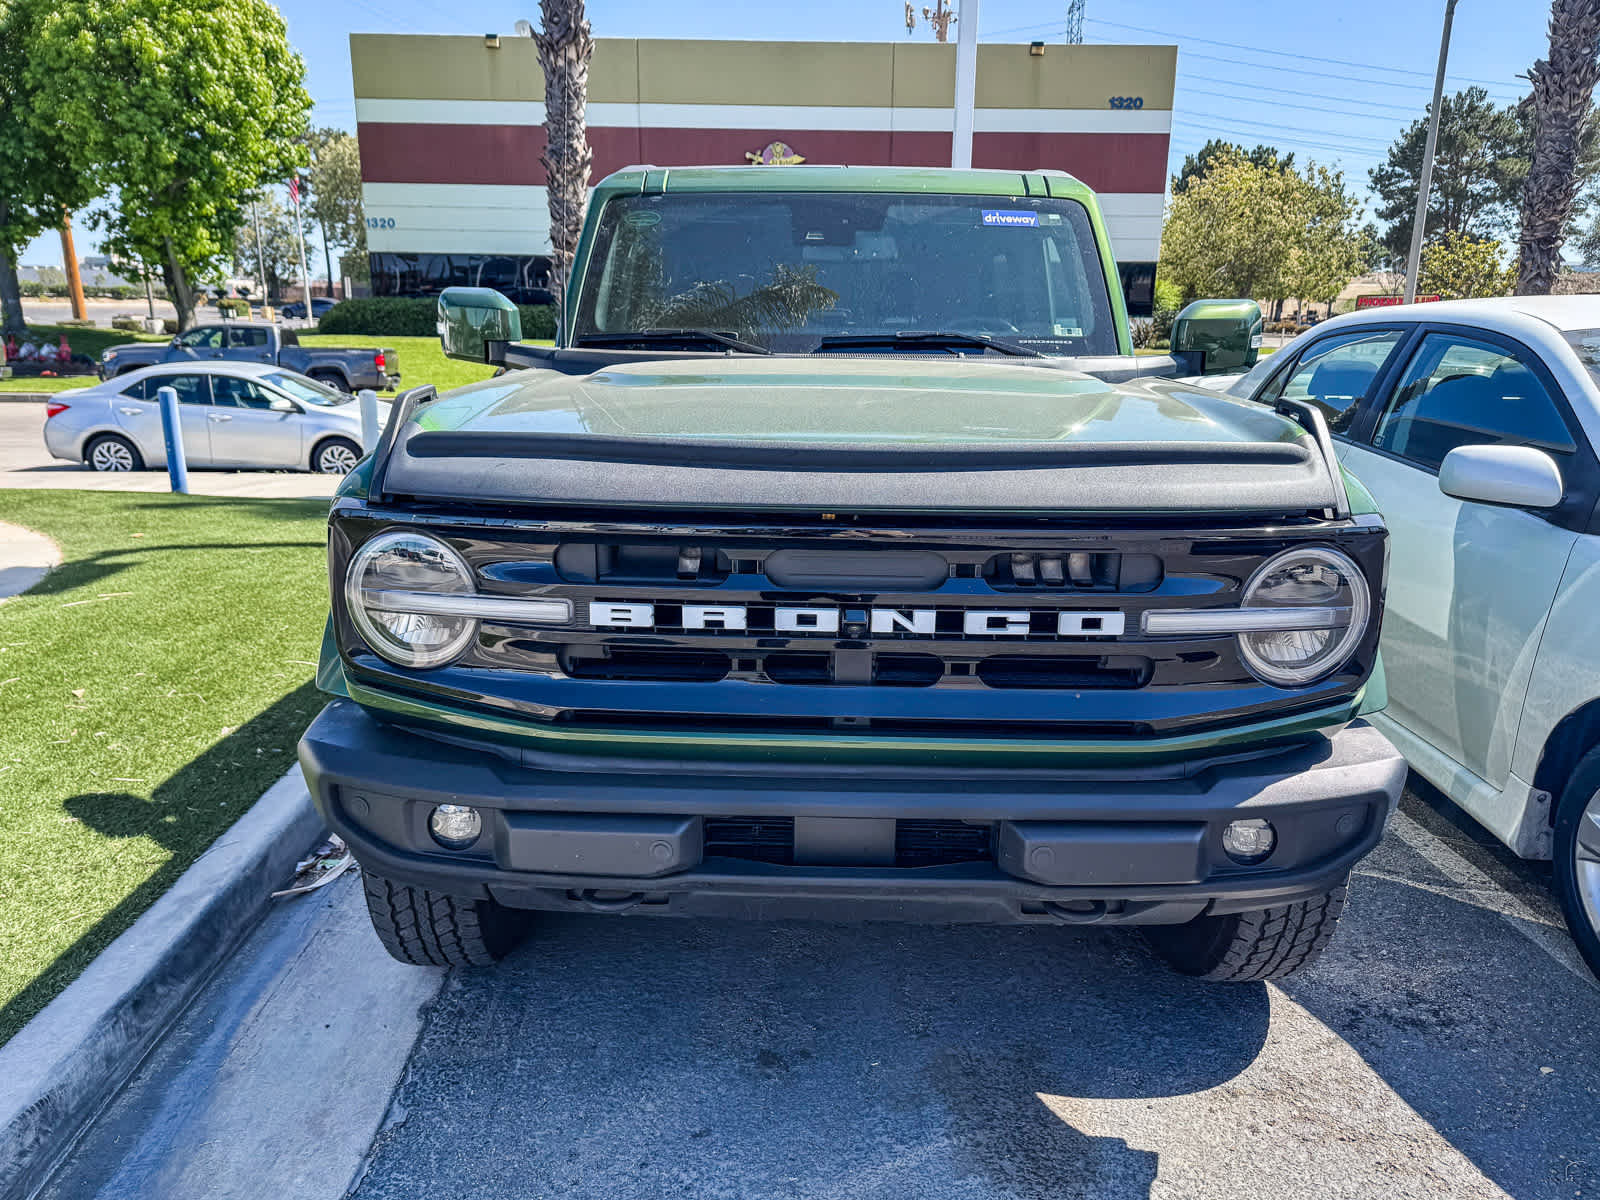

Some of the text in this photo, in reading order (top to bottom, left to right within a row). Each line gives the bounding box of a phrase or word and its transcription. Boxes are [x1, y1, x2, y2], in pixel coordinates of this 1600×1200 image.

[1109, 96, 1143, 110] 1320
[366, 217, 396, 229] 1320
[984, 211, 1036, 226] driveway
[589, 600, 1125, 636] BRONCO
